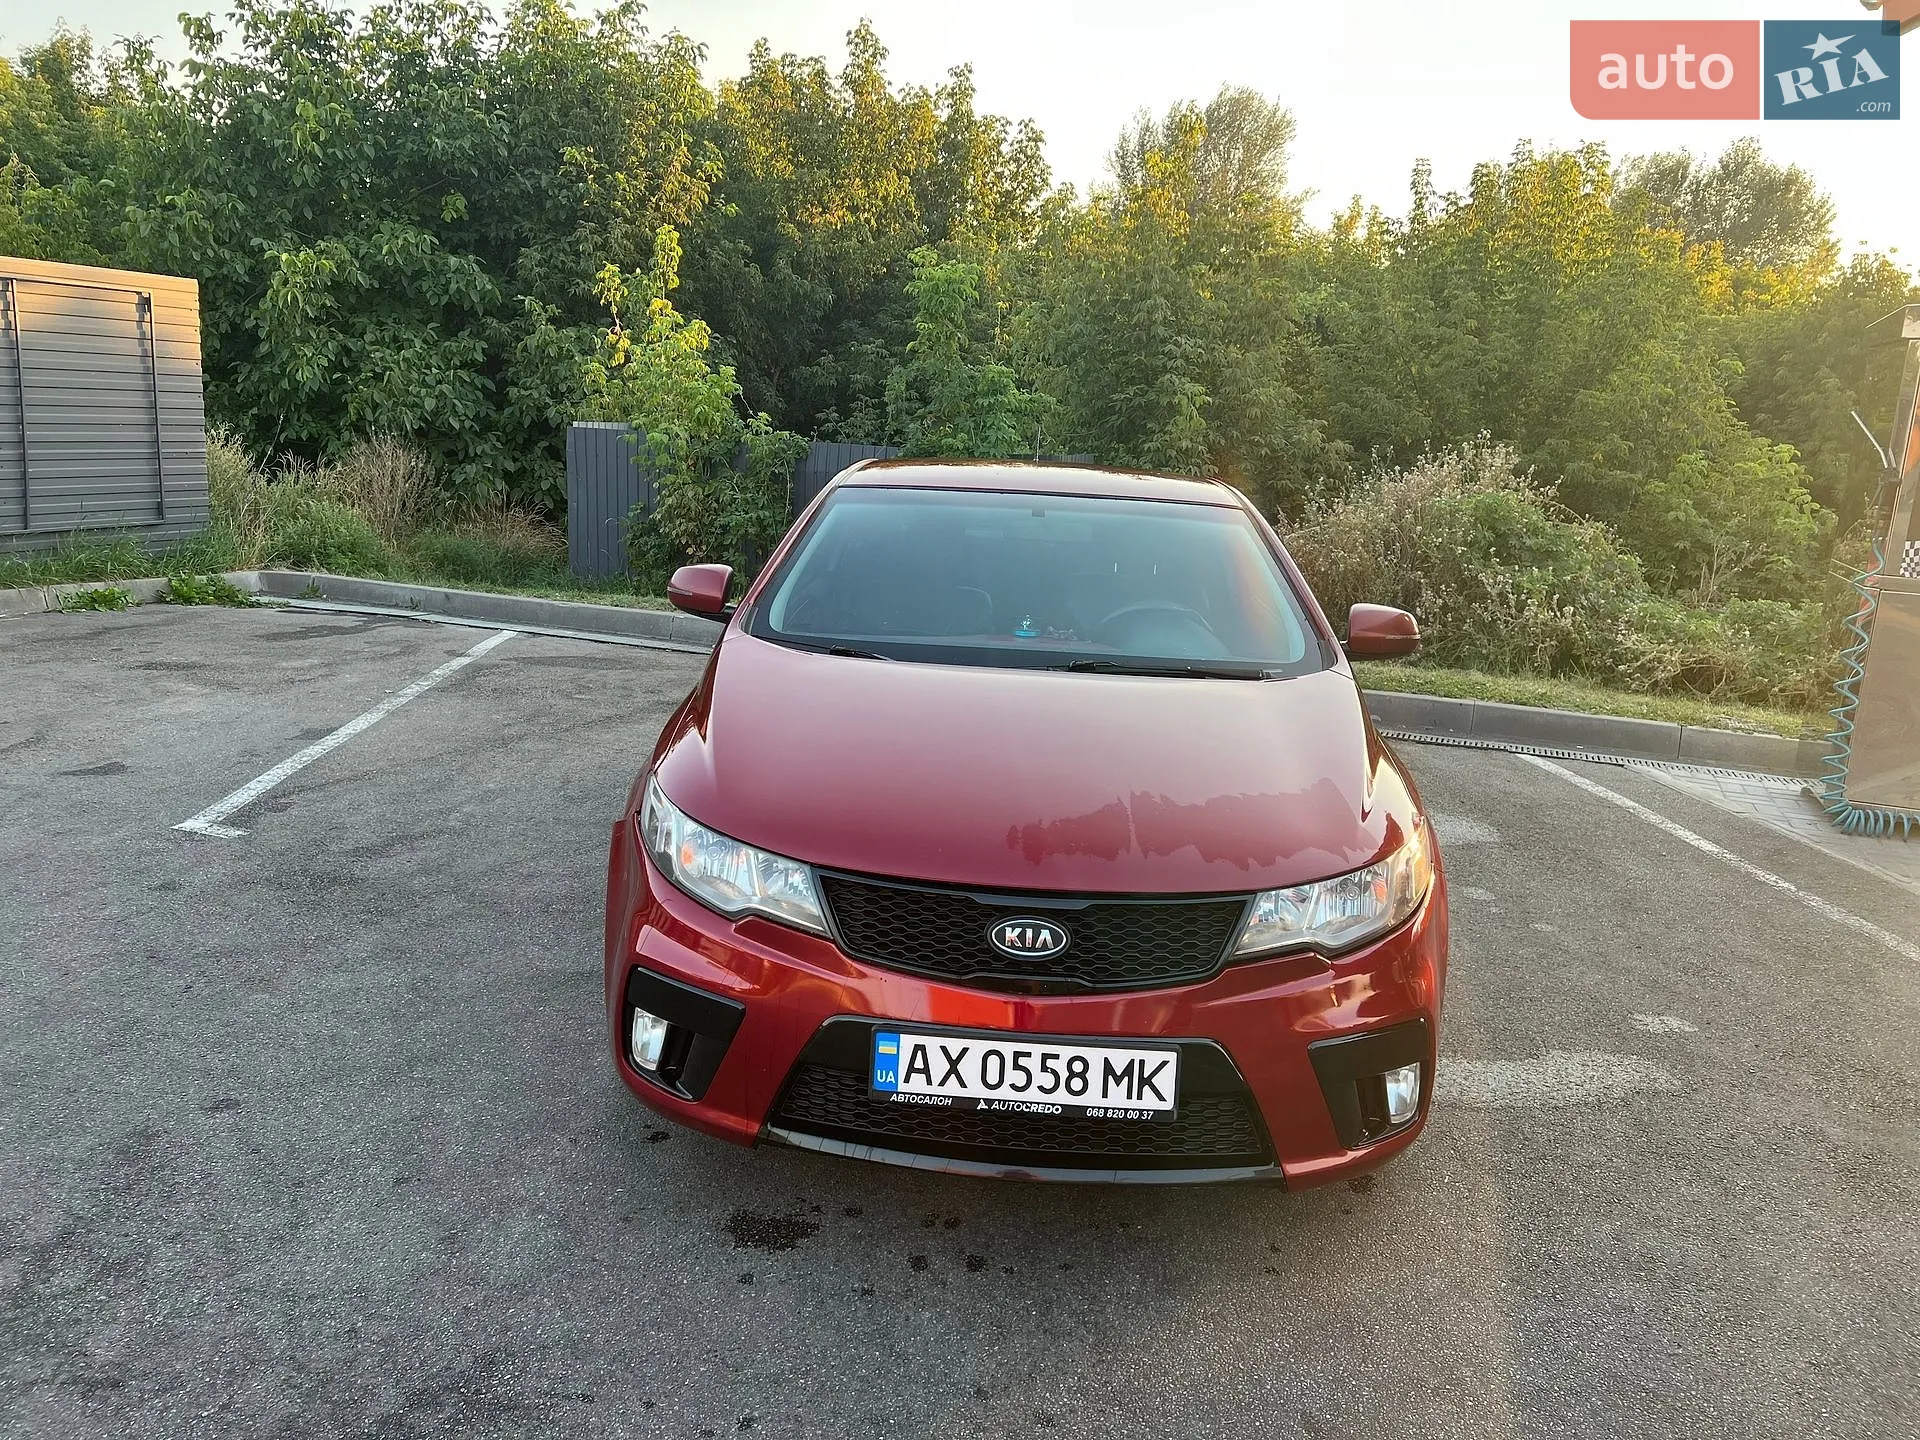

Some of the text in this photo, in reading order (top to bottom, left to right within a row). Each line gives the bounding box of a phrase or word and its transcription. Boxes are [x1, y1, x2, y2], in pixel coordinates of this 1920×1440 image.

[1004, 926, 1055, 949] KIA
[876, 1069, 896, 1085] UA
[903, 1043, 1171, 1103] AX 0558 MK
[889, 1092, 953, 1107] АВТОСАЛОН
[990, 1100, 1063, 1115] AUTOCREDO
[1086, 1107, 1154, 1121] 068 820 00 37
